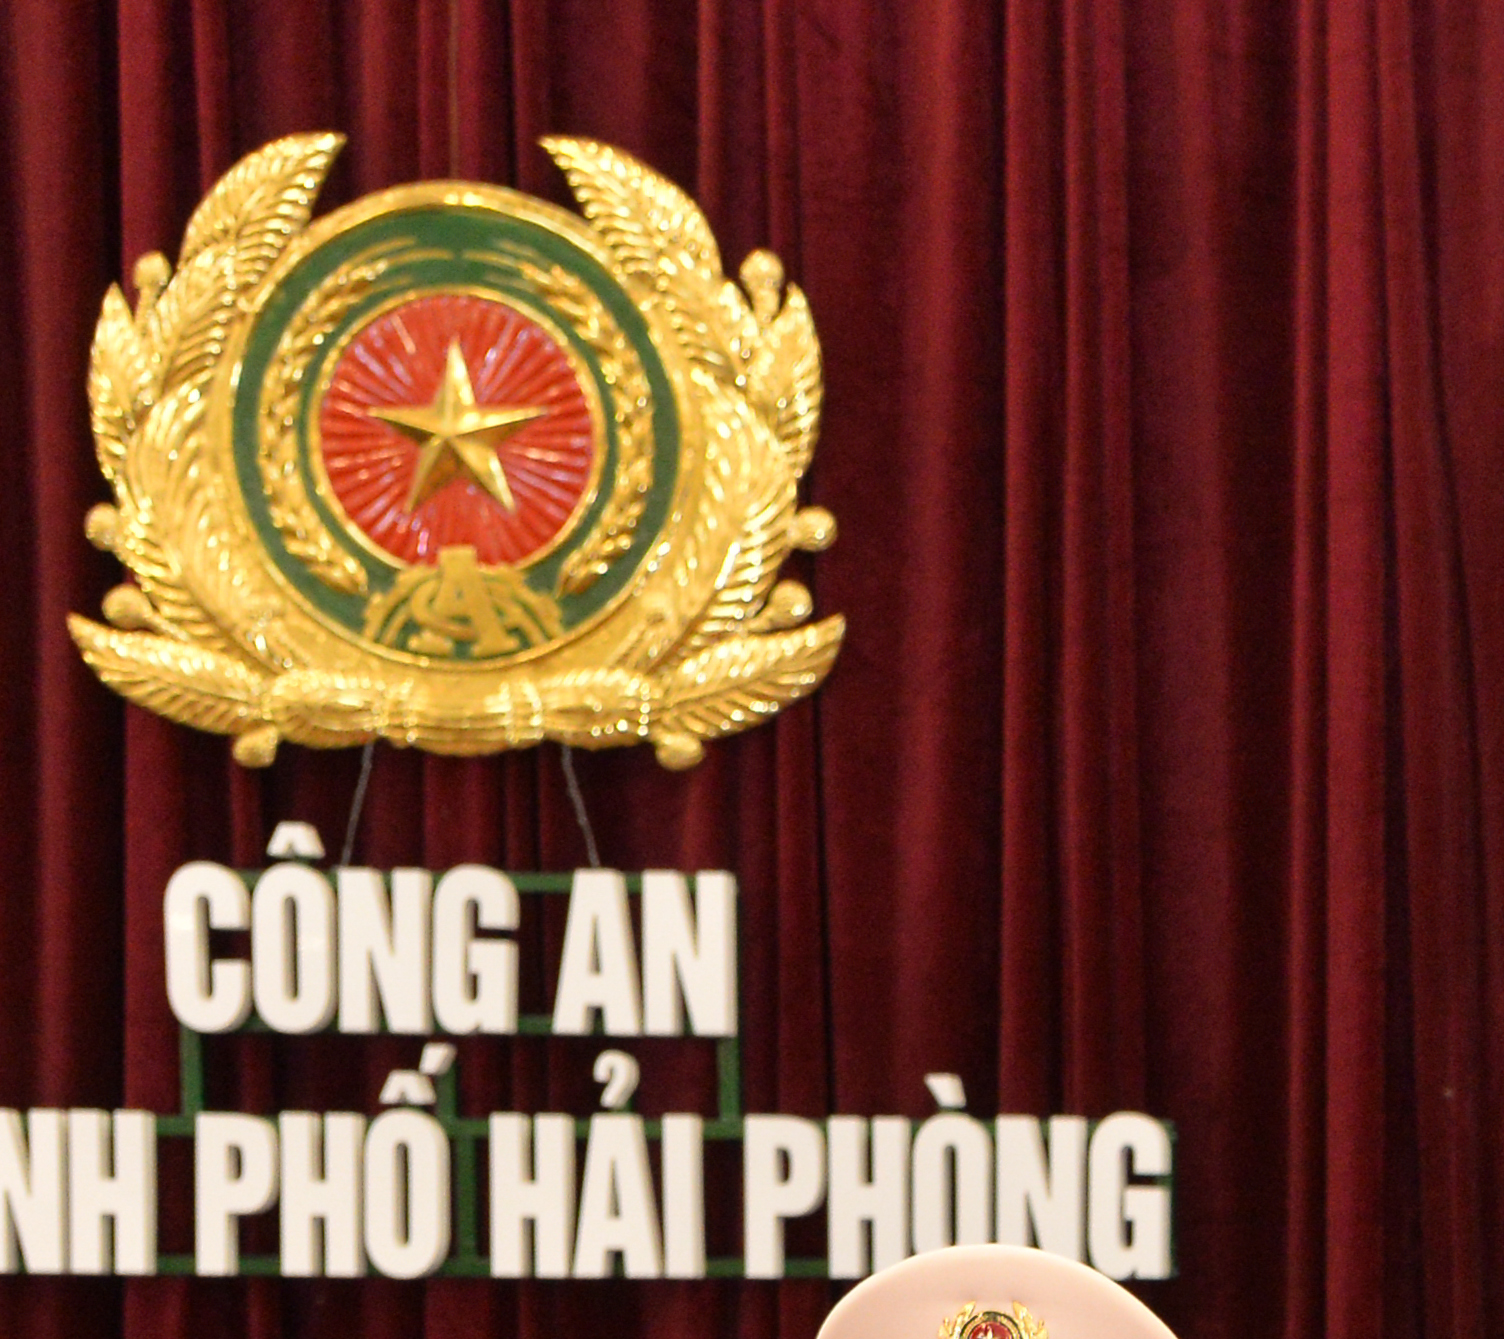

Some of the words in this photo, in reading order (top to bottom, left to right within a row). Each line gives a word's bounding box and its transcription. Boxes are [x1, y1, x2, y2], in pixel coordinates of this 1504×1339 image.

[164, 821, 520, 1035] CÔNG
[552, 868, 738, 1037] AN
[195, 1043, 453, 1279] PHỐ
[488, 1050, 704, 1279] HẢI
[743, 1073, 1173, 1280] PHÒNG
